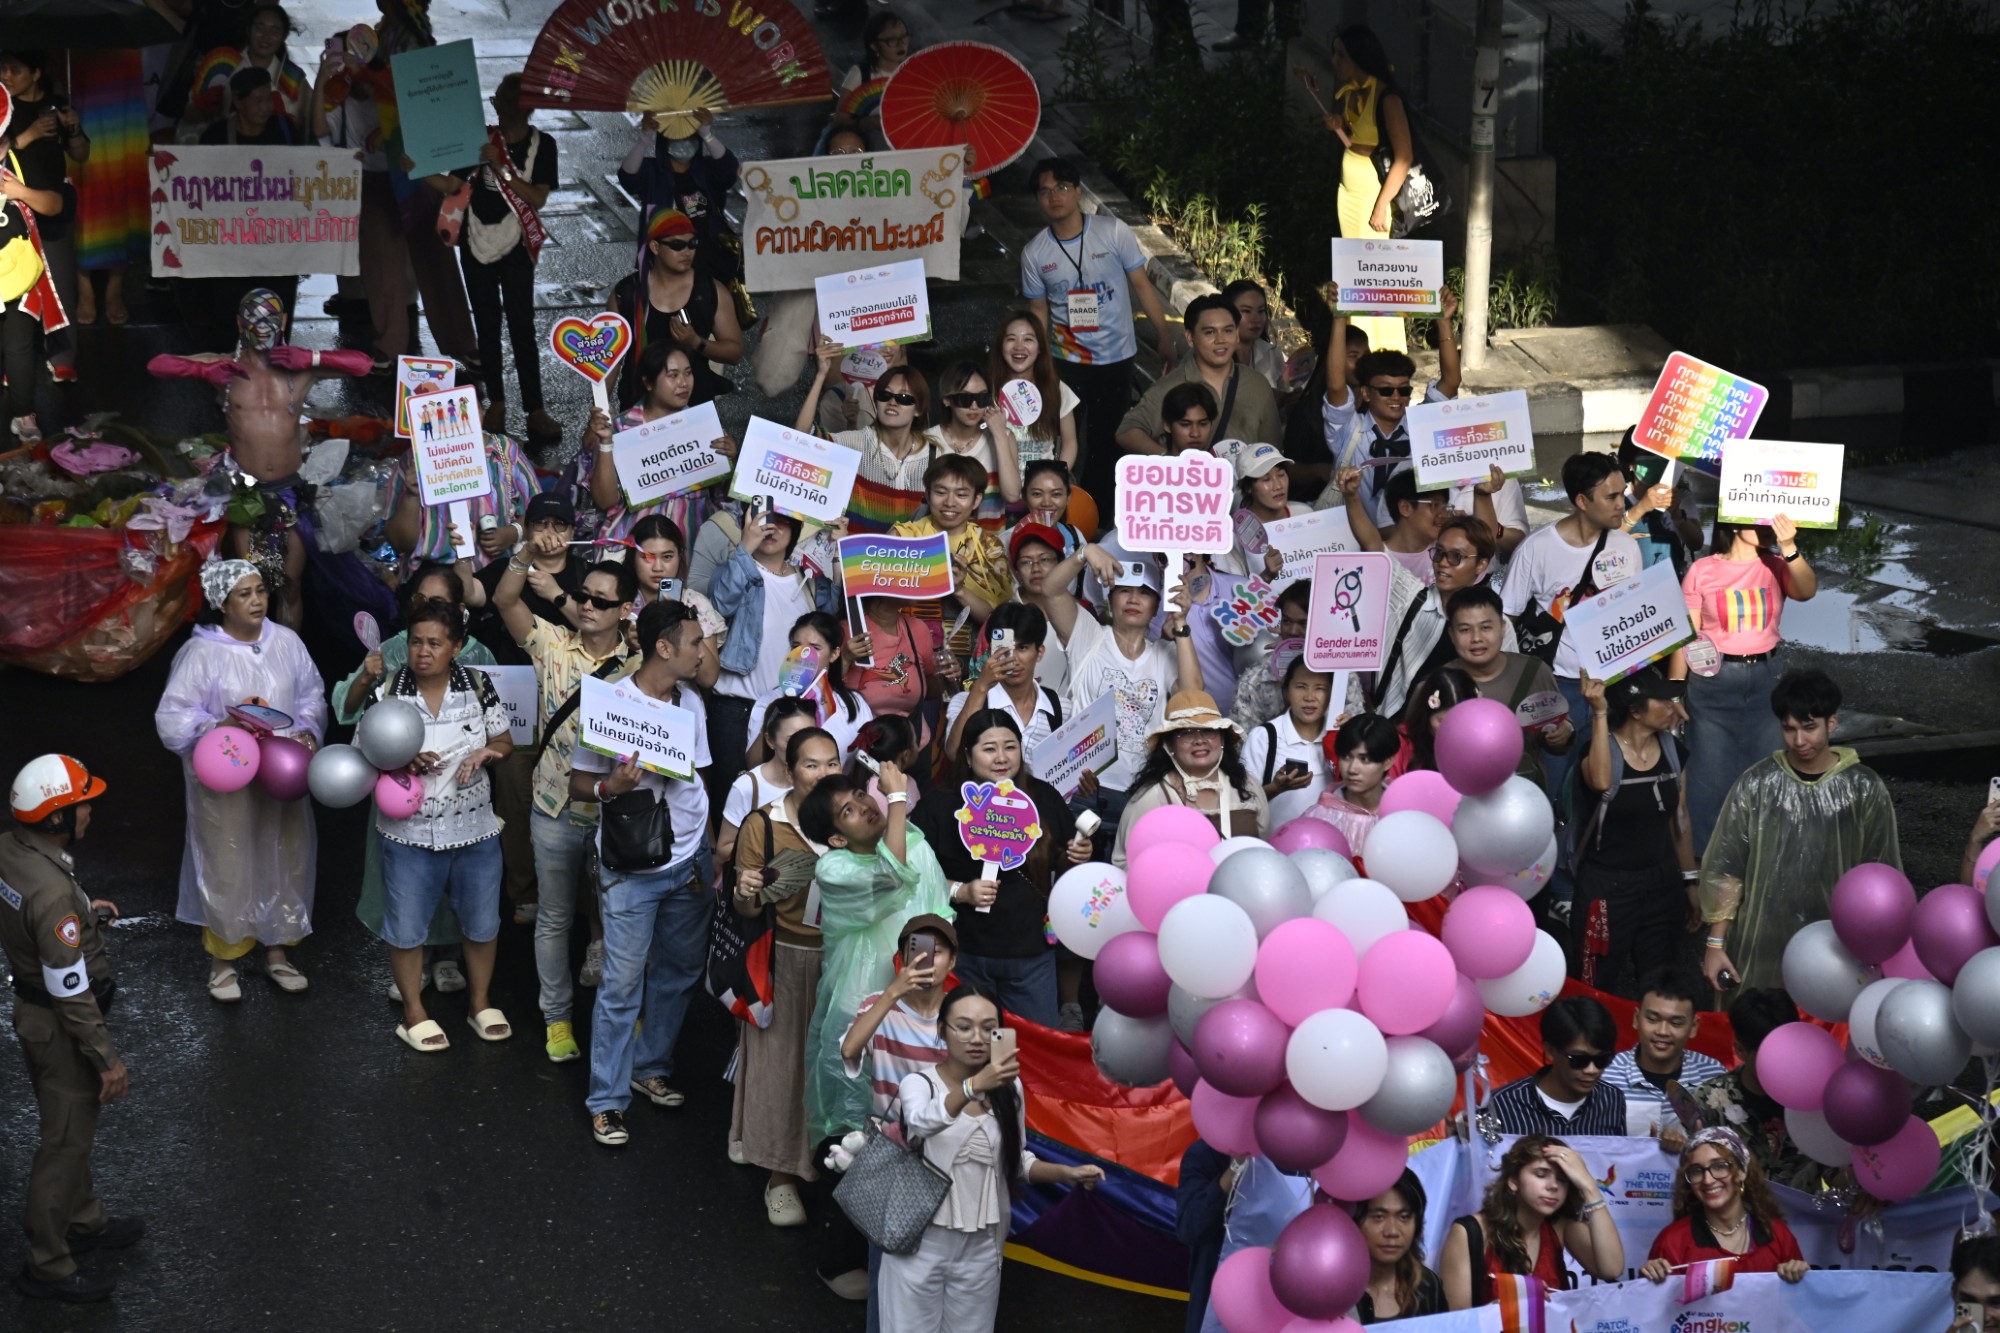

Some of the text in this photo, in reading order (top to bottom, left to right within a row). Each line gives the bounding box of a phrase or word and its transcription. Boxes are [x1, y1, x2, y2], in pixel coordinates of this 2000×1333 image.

[542, 43, 586, 102] SEX
[727, 0, 807, 87] WORK
[1480, 86, 1495, 109] 7
[171, 159, 358, 211] กฎหมายใหม่ยุคใหม่
[789, 157, 912, 200] ปลดล็อค
[176, 208, 359, 245] ของพนักงานบริการ
[756, 212, 945, 255] ความผิดค้าประเวณี
[1357, 260, 1418, 273] โลกสวยงาม
[1353, 277, 1424, 288] เพราะความรัก
[829, 294, 918, 320] ความรักออกแบบไม่ได้
[1343, 290, 1434, 303] มีความหลากหลาย
[1069, 307, 1098, 315] PARADE
[577, 334, 605, 349] สวัสดี
[573, 350, 614, 364] เจ้าหัวใจ
[1670, 378, 1748, 419] เท่าเทียมกัน
[1436, 427, 1505, 448] อิสระที่จะรัก
[1694, 432, 1722, 452] ทุกค
[427, 441, 475, 457] ไม่แบ่งแยก
[641, 440, 700, 467] หยุดตีตรา
[1421, 443, 1526, 468] คือสิทธิ์ของทุกคน
[432, 456, 472, 470] ไม่กีดกัน
[637, 452, 714, 488] เปิดตา-เปิดใจ
[766, 454, 827, 487] รักก็คือรัก
[1126, 459, 1222, 488] ยอมรับ
[433, 479, 479, 496] และโอกาส
[755, 468, 828, 505] ไม่มีคำว่าผิด
[1728, 487, 1830, 507] มีค่าเท่ากันเสมอ
[1126, 490, 1222, 515] เคารพ
[1126, 515, 1222, 542] ให้เกียรติ
[865, 545, 926, 559] Gender
[861, 559, 931, 576] Equality
[873, 573, 920, 588] for all
[1602, 604, 1657, 640] รักด้วยใจ
[1315, 637, 1378, 648] Gender Lens
[1595, 617, 1674, 664] ไม่ใช่ด้วยเพศ
[1313, 648, 1377, 659] มองเห็นความแตกต่าง
[606, 712, 669, 740] เพราะหัวใจ
[588, 717, 686, 761] ไม่เคยมีข้อจำกัด
[1048, 738, 1111, 787] างความเท่าเทียม
[985, 808, 1015, 825] รักเรา
[970, 825, 1026, 843] จะทันสมัย
[1625, 1180, 1645, 1189] THE
[1638, 1172, 1671, 1181] PATCH
[1597, 1319, 1629, 1330] PATCH
